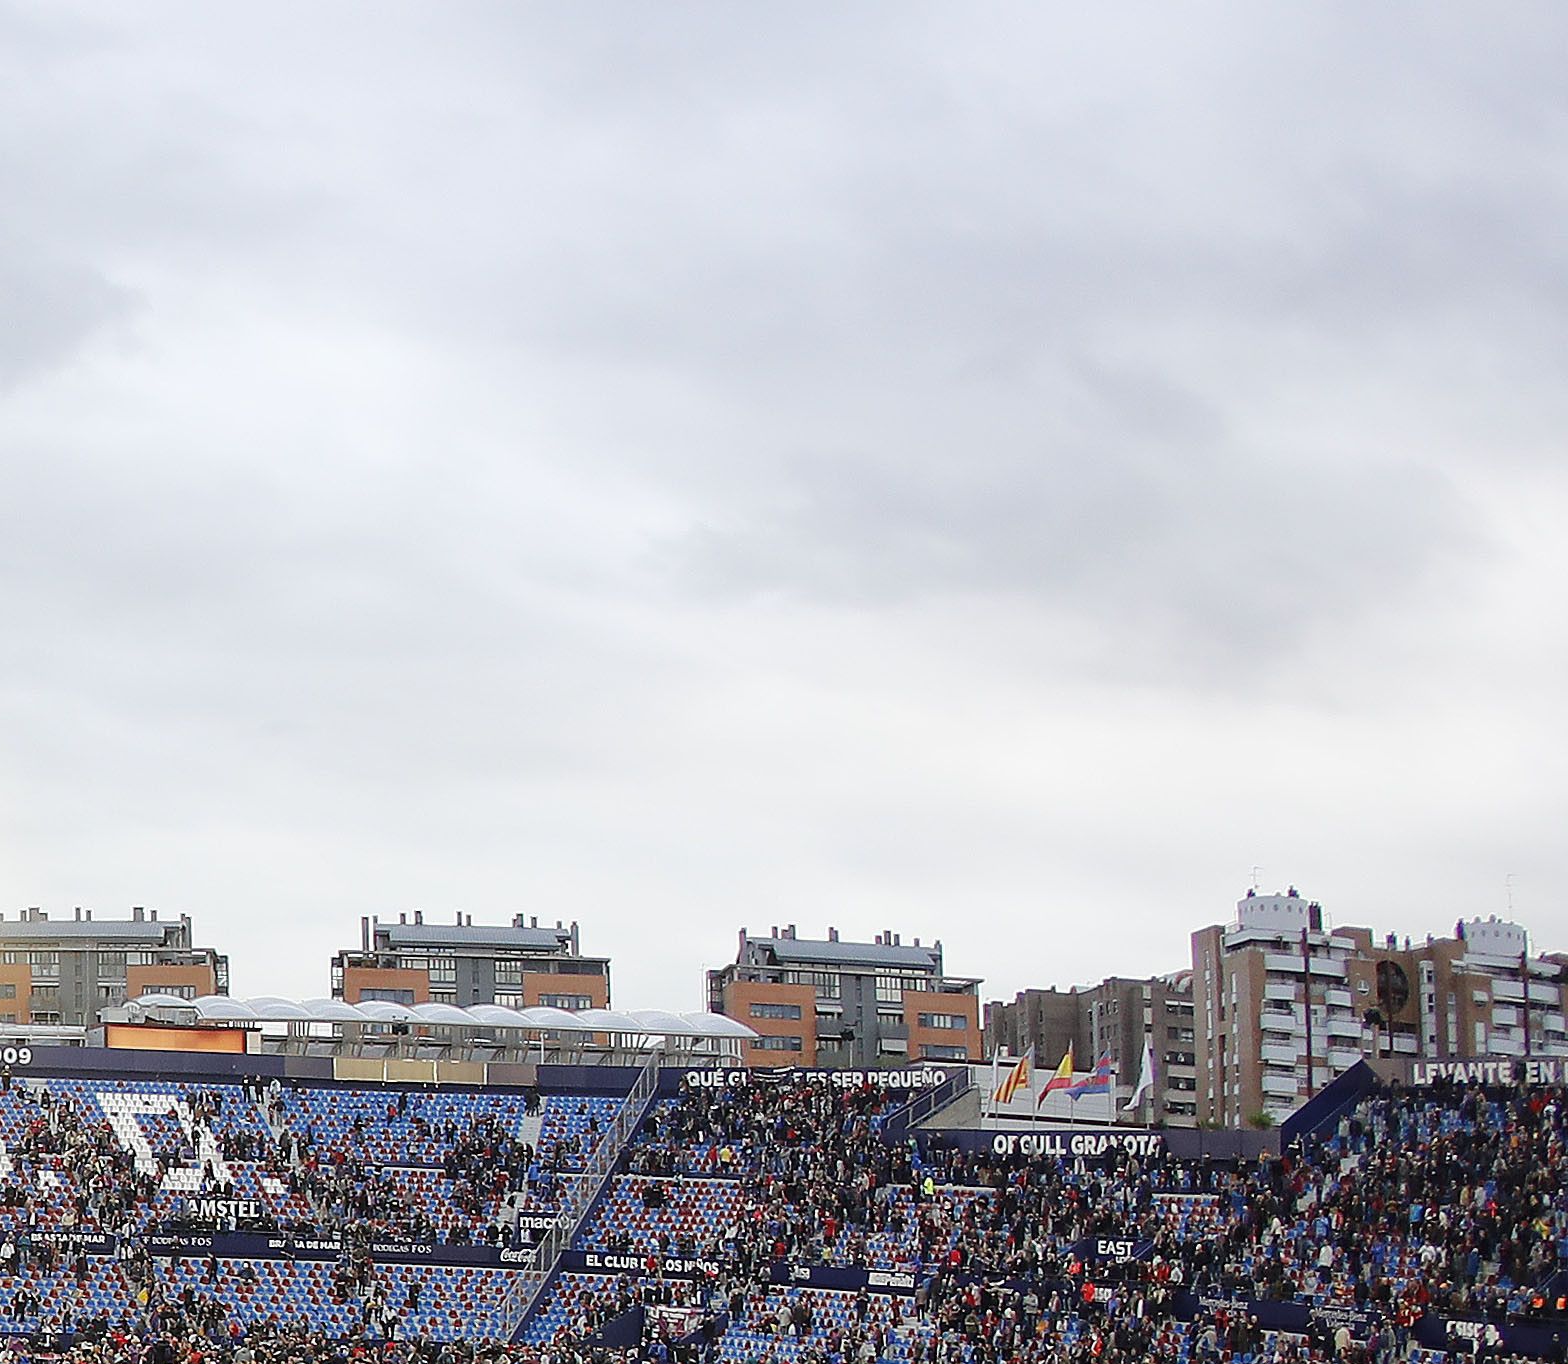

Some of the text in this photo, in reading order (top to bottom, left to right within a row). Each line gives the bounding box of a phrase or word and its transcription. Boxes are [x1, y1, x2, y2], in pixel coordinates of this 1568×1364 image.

[687, 1067, 724, 1087] QUÉ
[1070, 1135, 1161, 1157] GRAOTA
[1097, 1240, 1133, 1257] EAST
[585, 1254, 602, 1268] EL
[604, 1255, 639, 1270] CLUB
